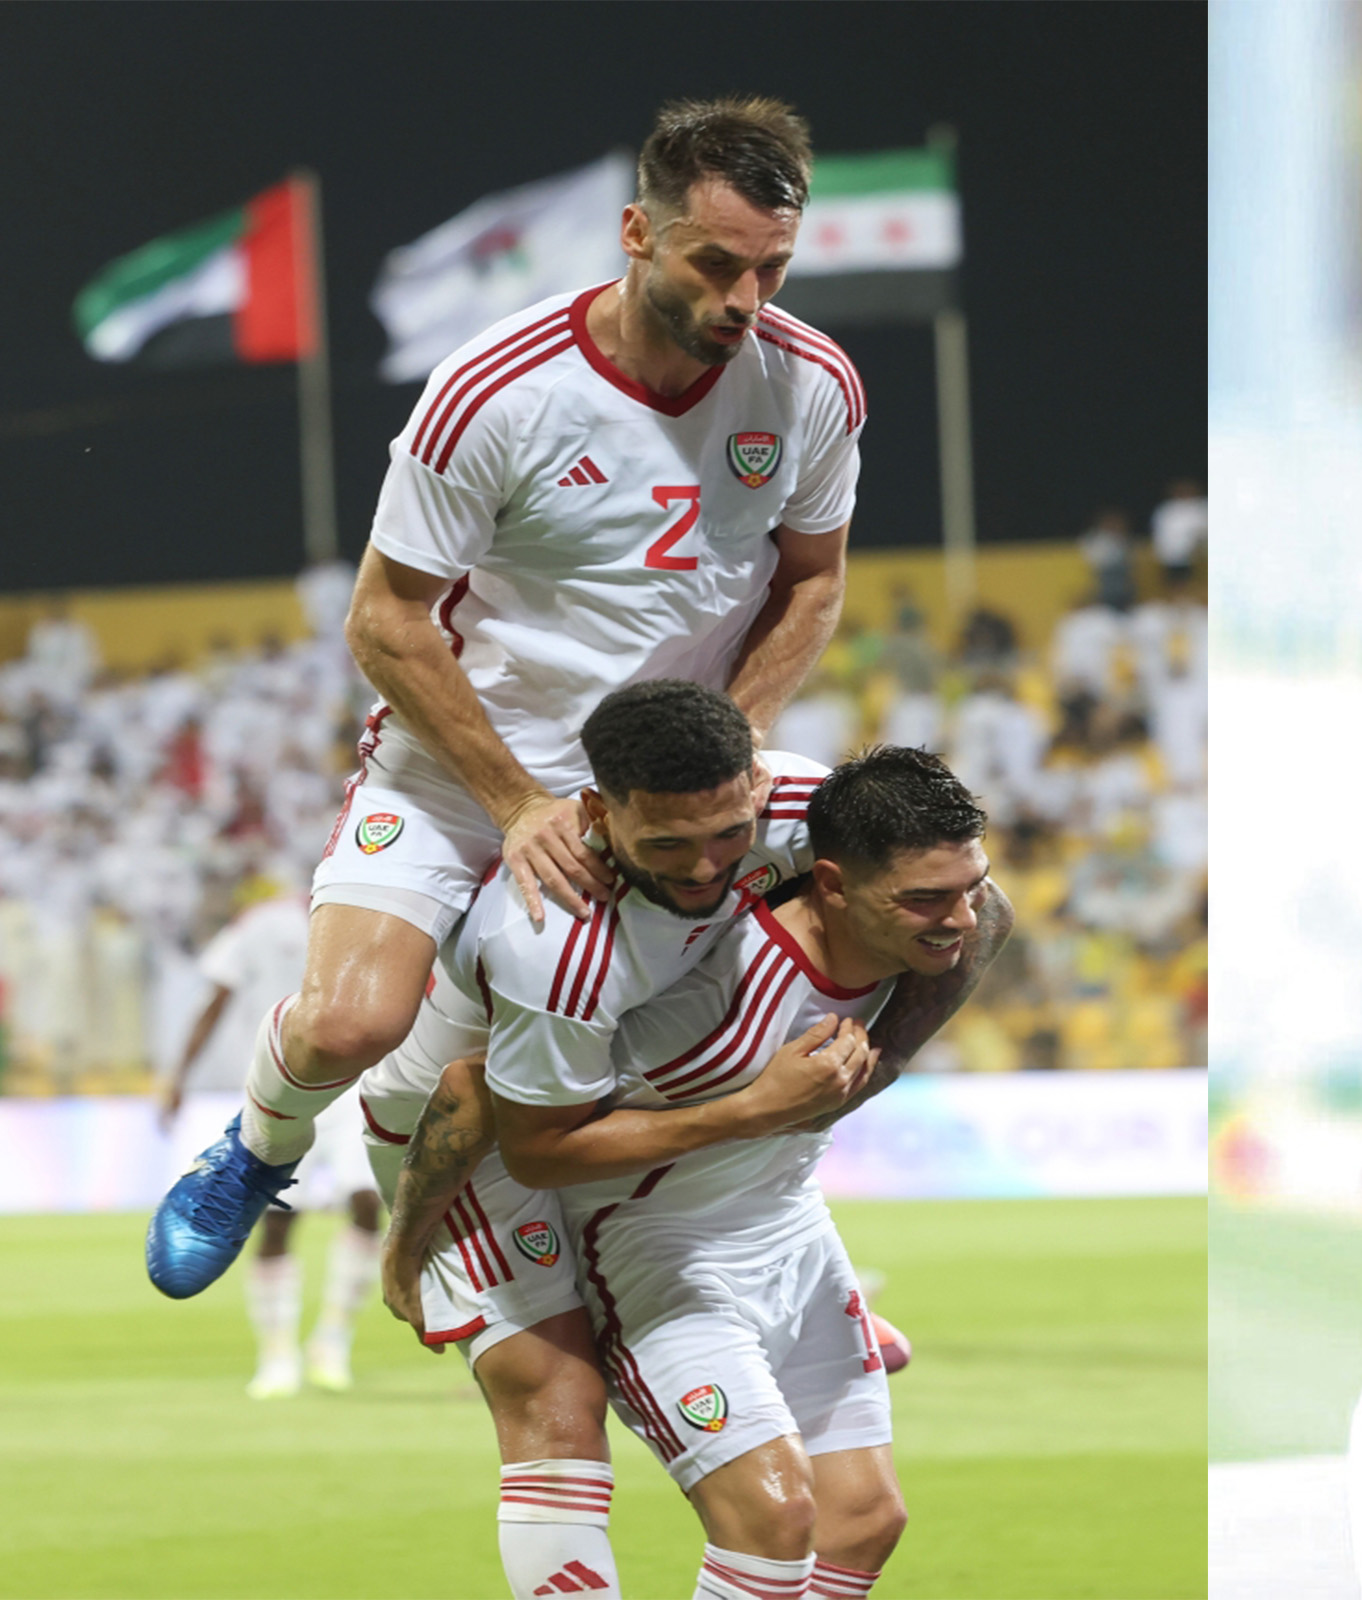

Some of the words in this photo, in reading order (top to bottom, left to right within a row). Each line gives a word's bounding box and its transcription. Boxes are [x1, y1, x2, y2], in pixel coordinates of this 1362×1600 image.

[742, 447, 769, 455] UAE
[644, 484, 700, 570] 2
[527, 1233, 548, 1242] UAE
